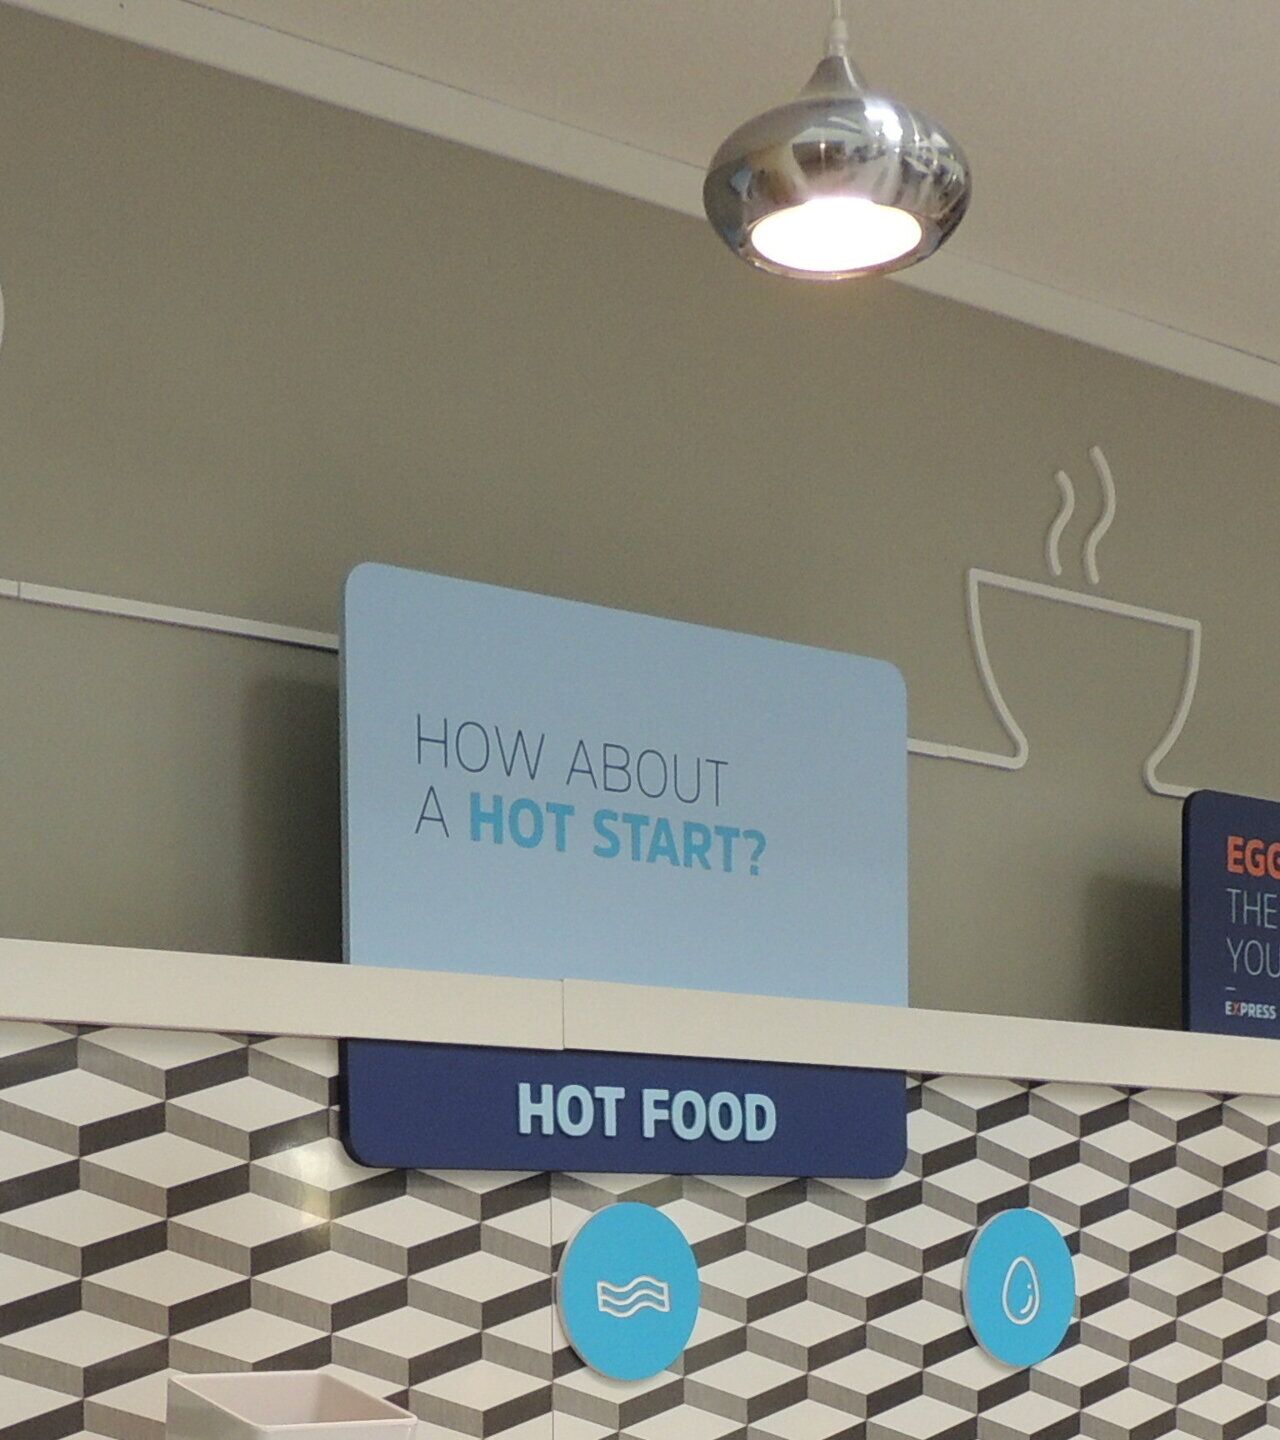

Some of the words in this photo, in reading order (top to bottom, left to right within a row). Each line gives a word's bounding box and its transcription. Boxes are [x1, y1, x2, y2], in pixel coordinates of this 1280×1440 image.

[416, 713, 545, 780] HOW
[566, 739, 729, 807] ABOUT
[415, 785, 450, 838] A
[470, 791, 575, 853] HOT
[593, 808, 767, 876] START?
[1226, 888, 1278, 930] THE
[1225, 1001, 1277, 1020] EXPRESS
[518, 1082, 625, 1137] HOT
[642, 1088, 777, 1142] FOOD
